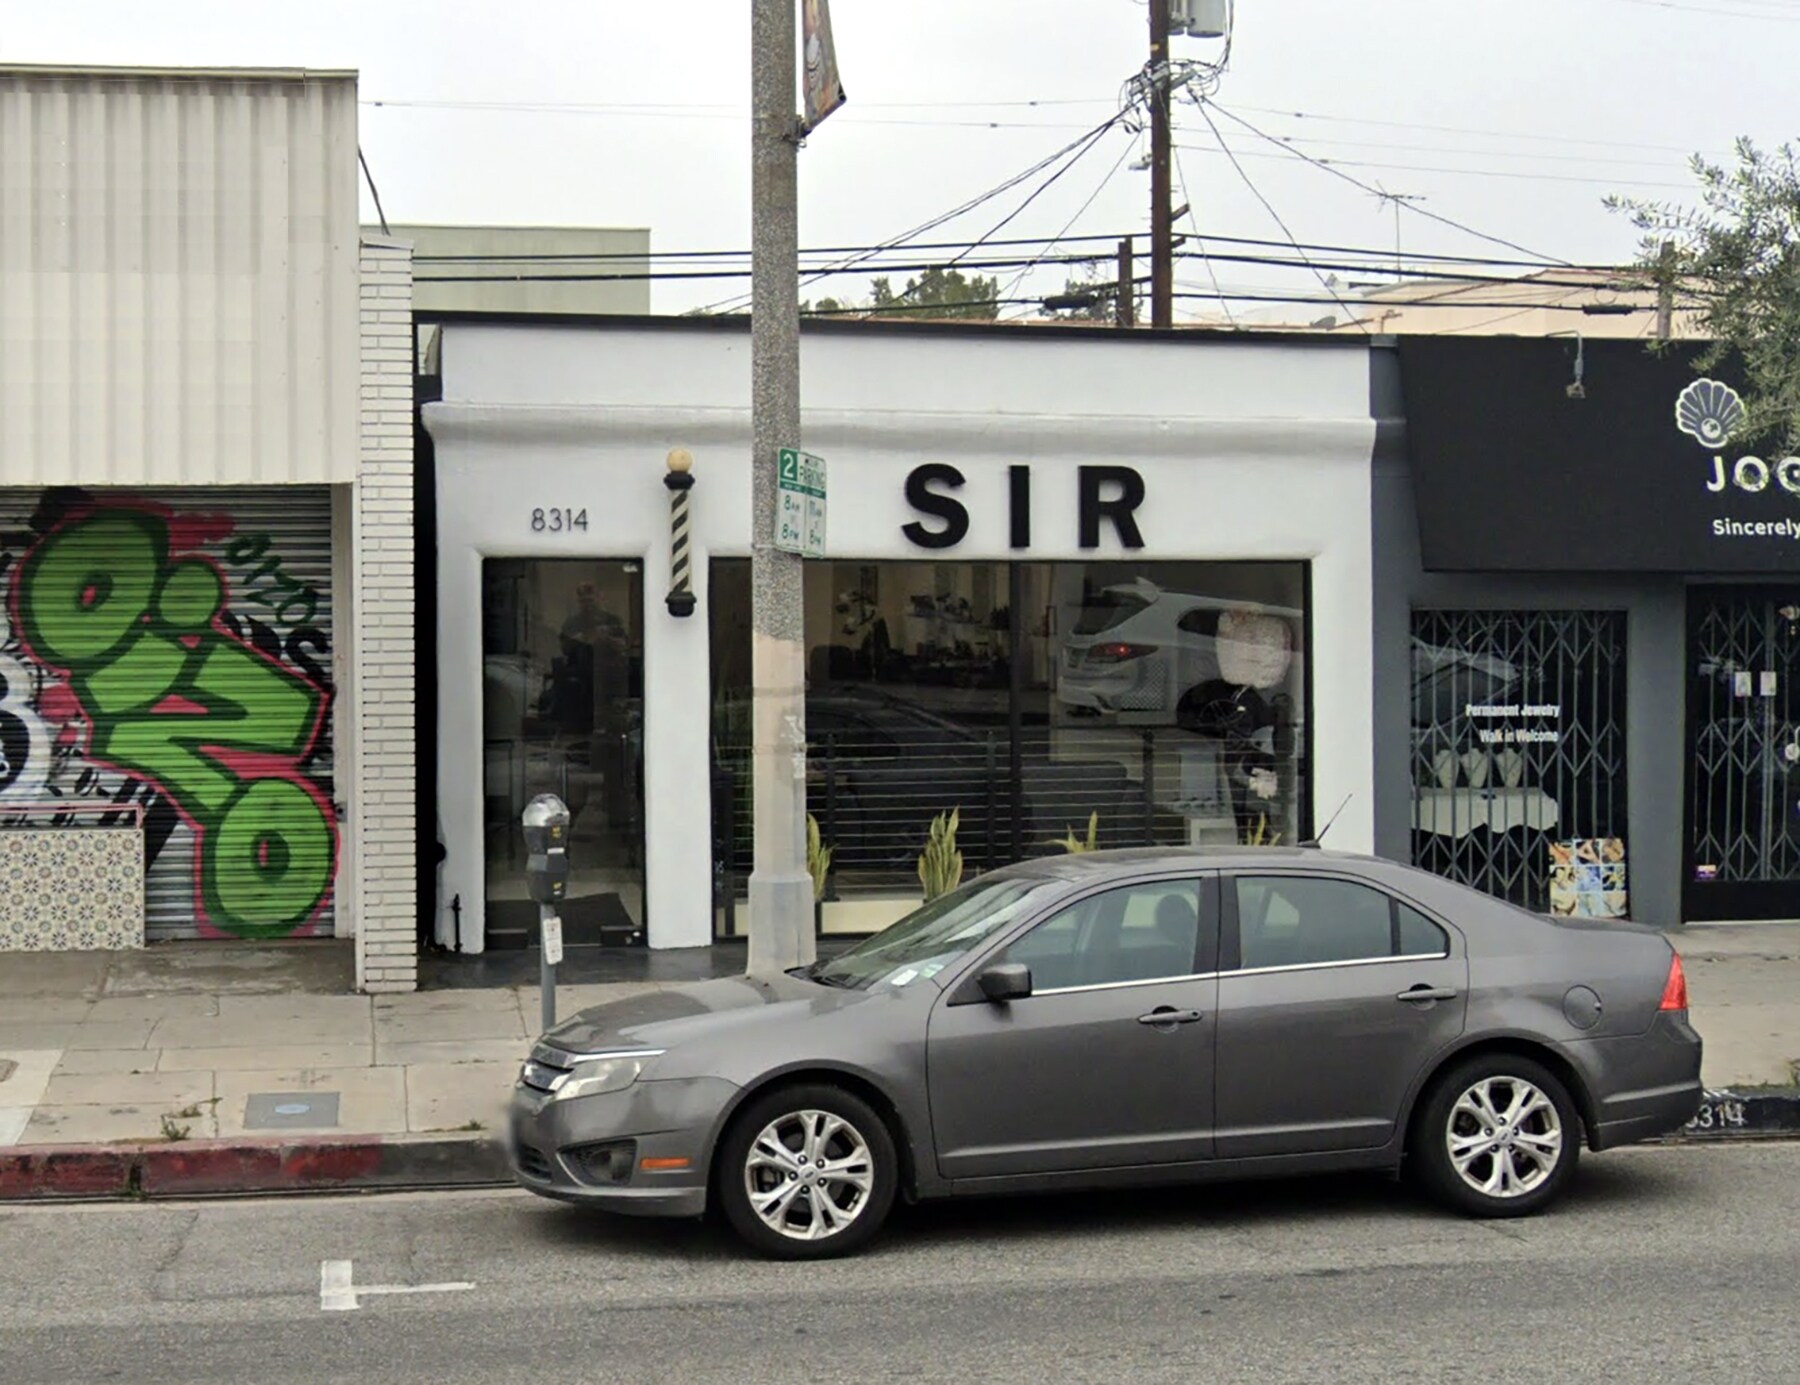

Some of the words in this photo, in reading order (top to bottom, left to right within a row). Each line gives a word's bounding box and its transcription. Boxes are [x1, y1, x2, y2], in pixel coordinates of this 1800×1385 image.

[783, 453, 794, 478] 2
[901, 463, 1146, 549] SIR
[531, 507, 589, 531] 8314
[1465, 703, 1519, 717] Permanent
[1521, 703, 1560, 718] Jewelry
[1480, 728, 1503, 743] Walk
[1504, 728, 1515, 742] in
[1516, 728, 1559, 743] Welcome
[1684, 1101, 1747, 1129] 314
